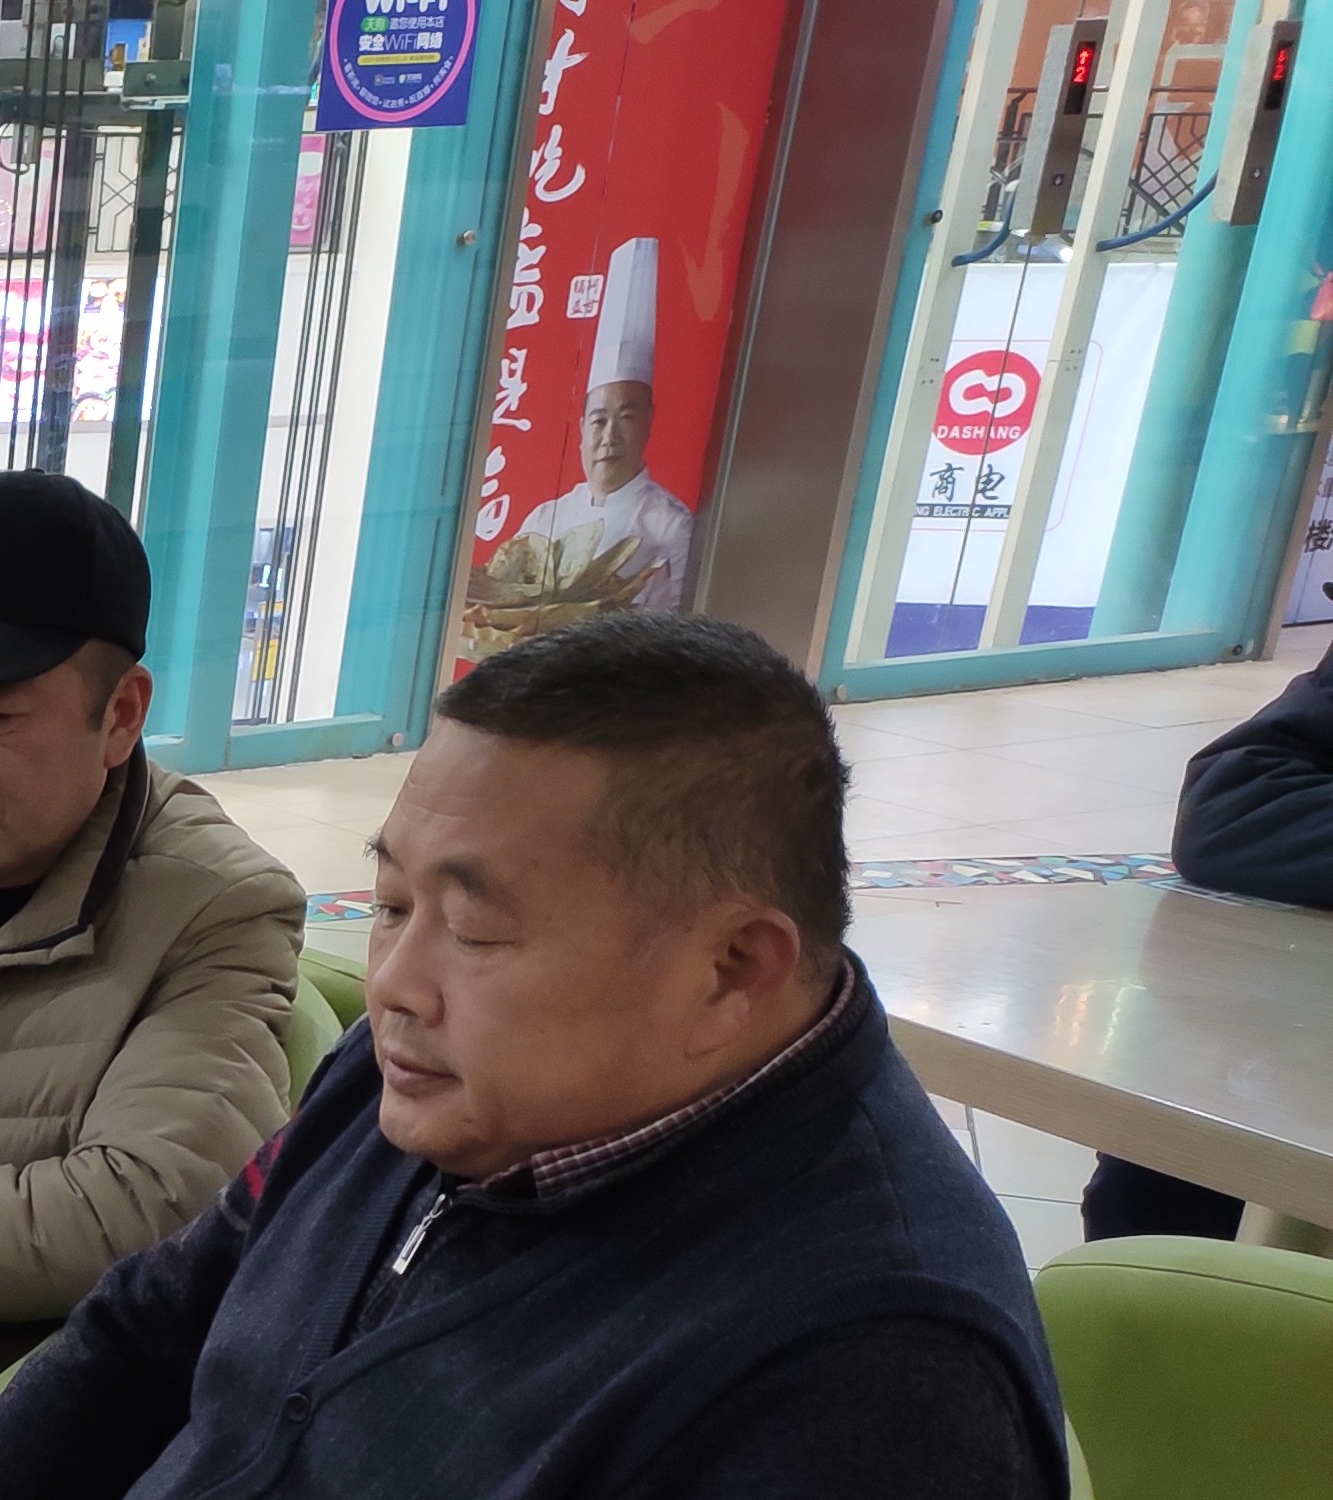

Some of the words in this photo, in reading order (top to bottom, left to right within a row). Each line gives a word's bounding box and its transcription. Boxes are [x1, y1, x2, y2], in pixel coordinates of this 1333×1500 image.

[1073, 66, 1087, 83] 2
[1271, 65, 1284, 80] 2
[936, 425, 1023, 439] DASHANG
[930, 462, 1006, 502] 商电
